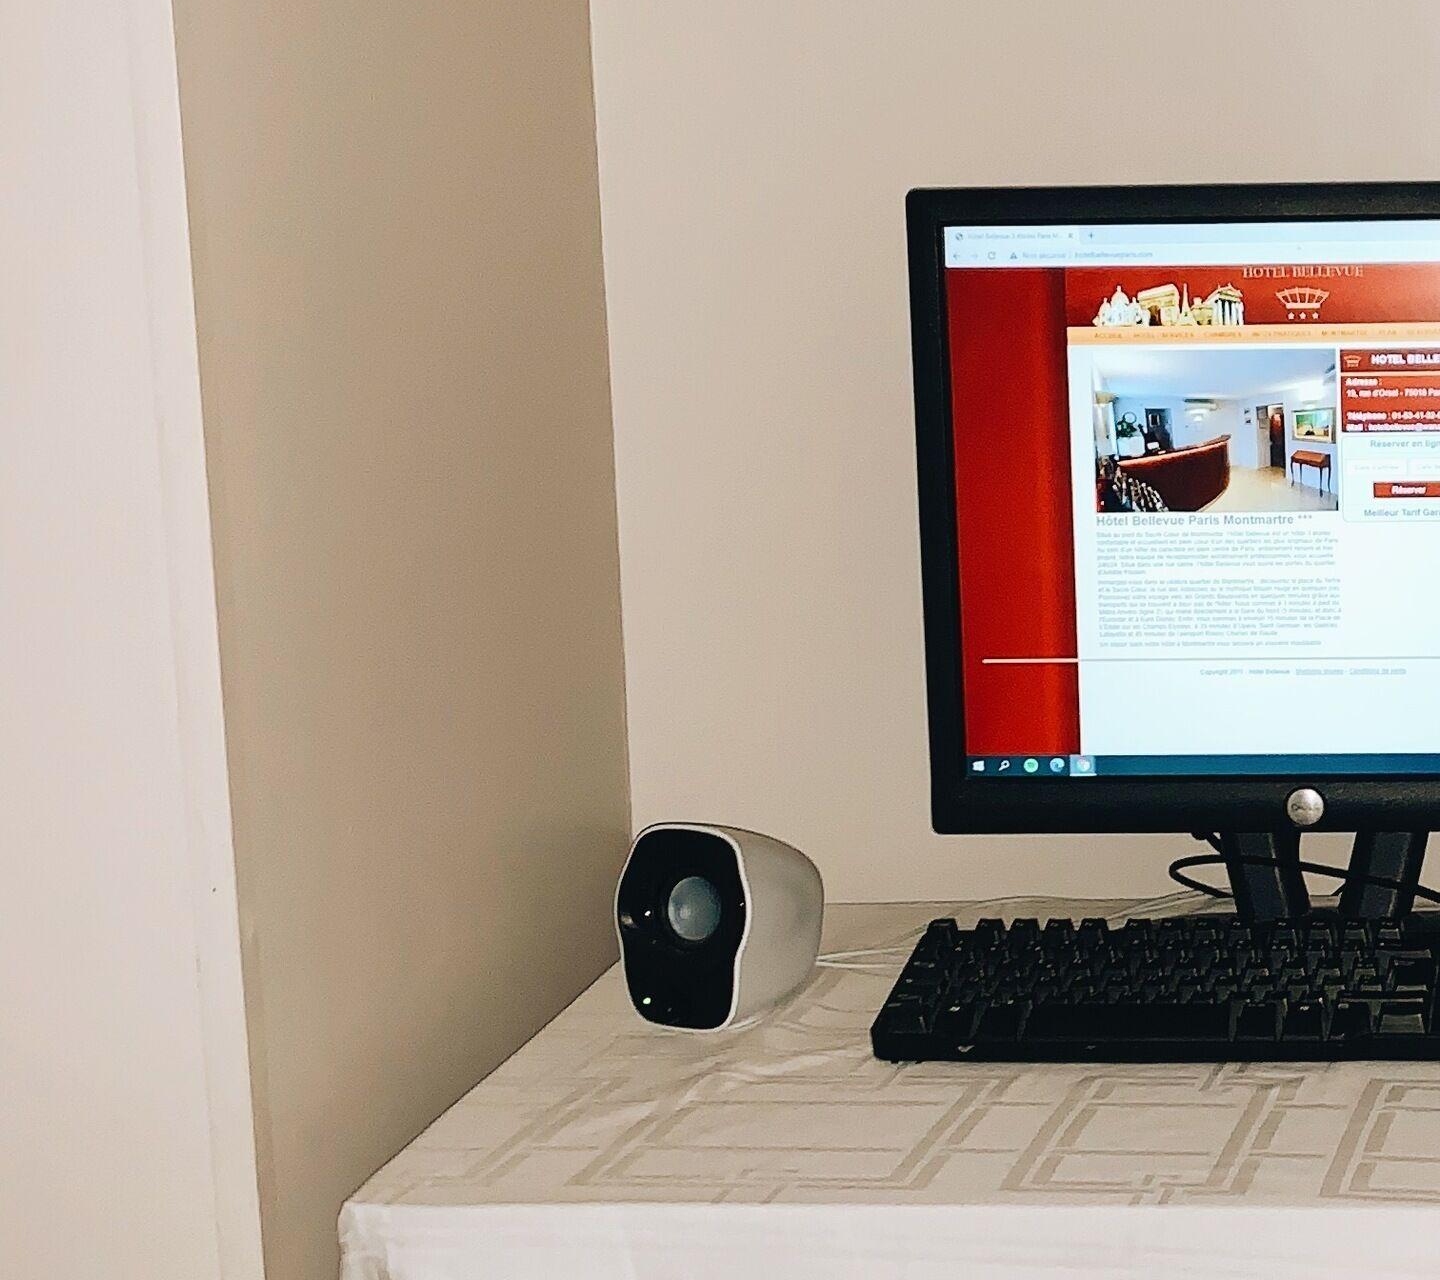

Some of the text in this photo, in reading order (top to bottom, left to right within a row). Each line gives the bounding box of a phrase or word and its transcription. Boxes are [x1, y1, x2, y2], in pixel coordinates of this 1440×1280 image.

[1243, 266, 1364, 278] HOTEL BELLEVUE
[1371, 353, 1406, 365] HOTEL
[1364, 508, 1399, 517] Meilleur
[1402, 508, 1420, 517] Tarif
[1096, 514, 1294, 526] Hôtel Bellevue Paris Montmartre
